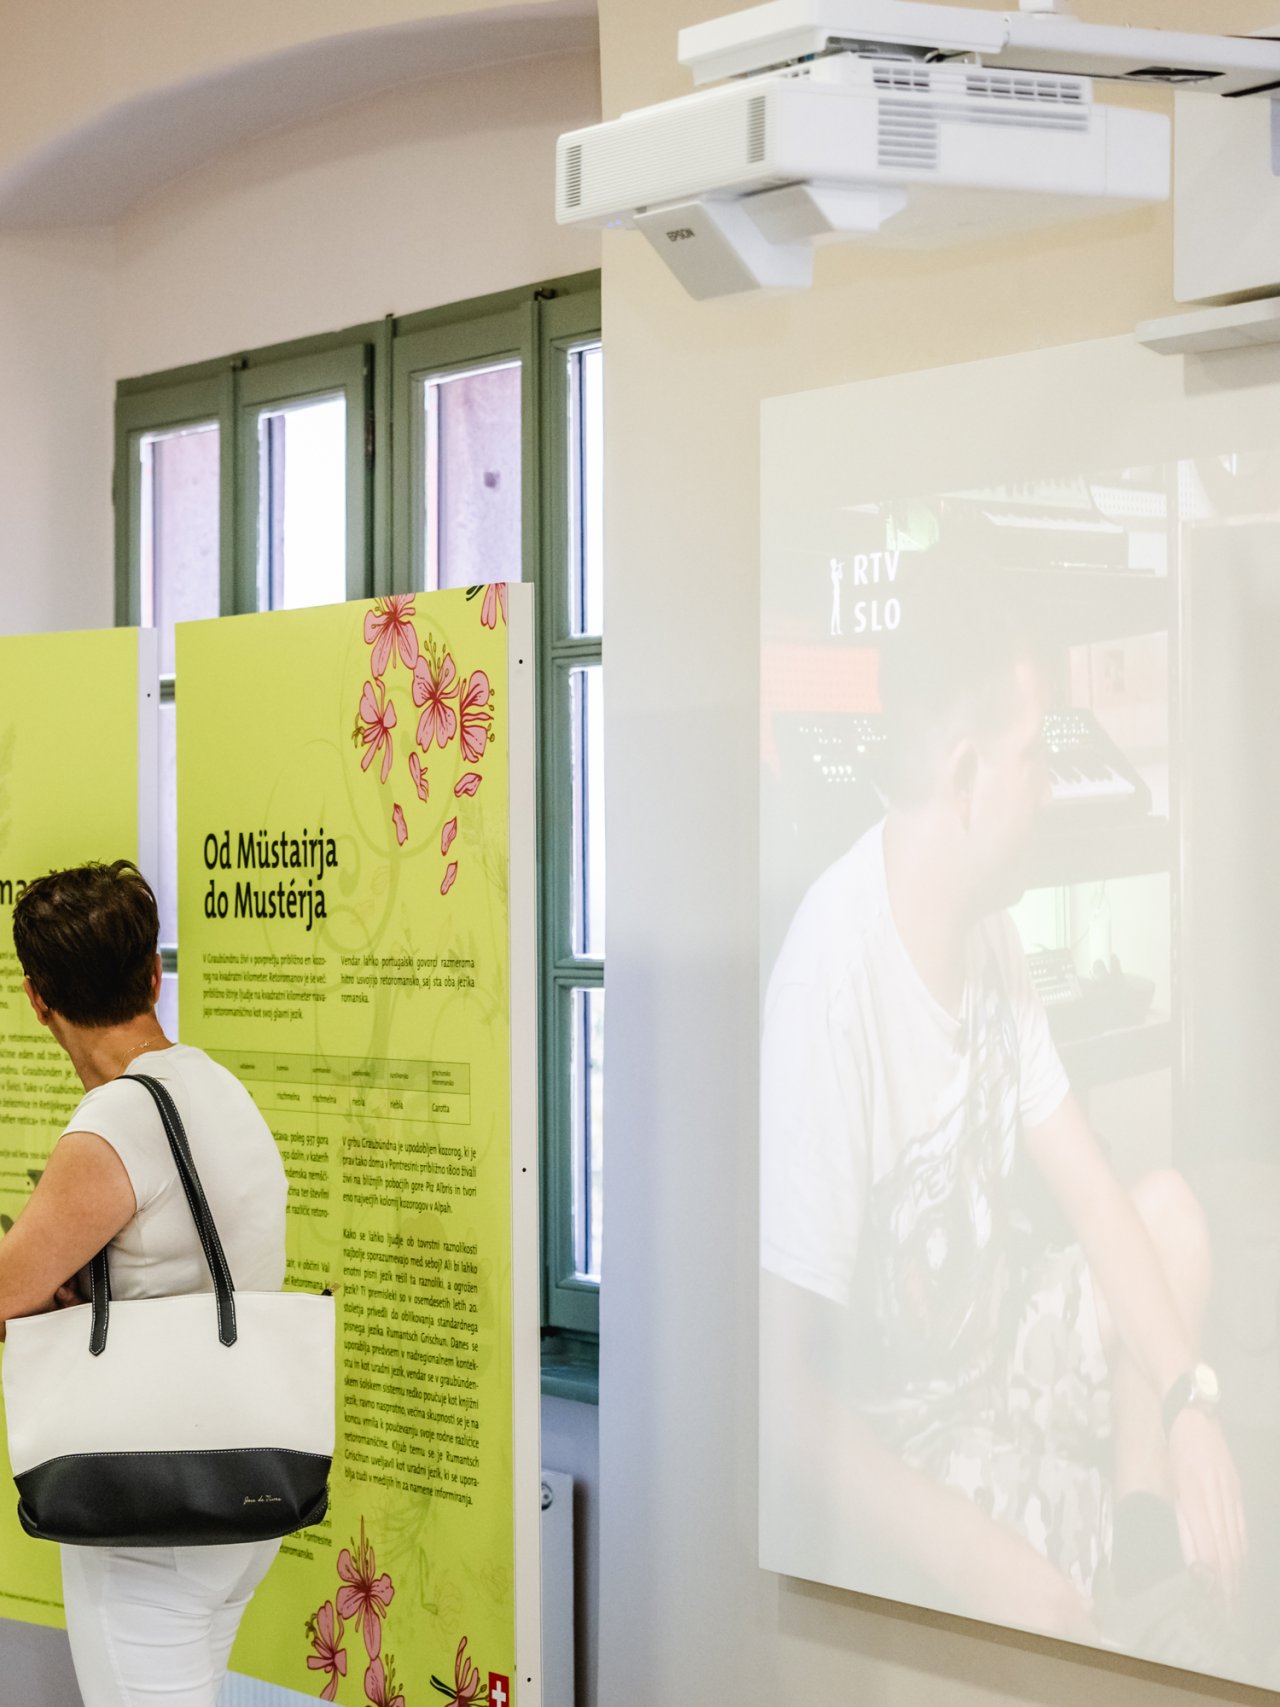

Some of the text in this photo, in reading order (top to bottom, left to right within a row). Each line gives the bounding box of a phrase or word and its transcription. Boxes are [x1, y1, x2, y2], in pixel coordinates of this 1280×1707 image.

[666, 229, 695, 242] EPSON
[853, 550, 900, 585] RTV
[853, 598, 901, 633] SLO
[204, 827, 338, 881] Od Müstairja
[204, 878, 327, 932] do Mustérja
